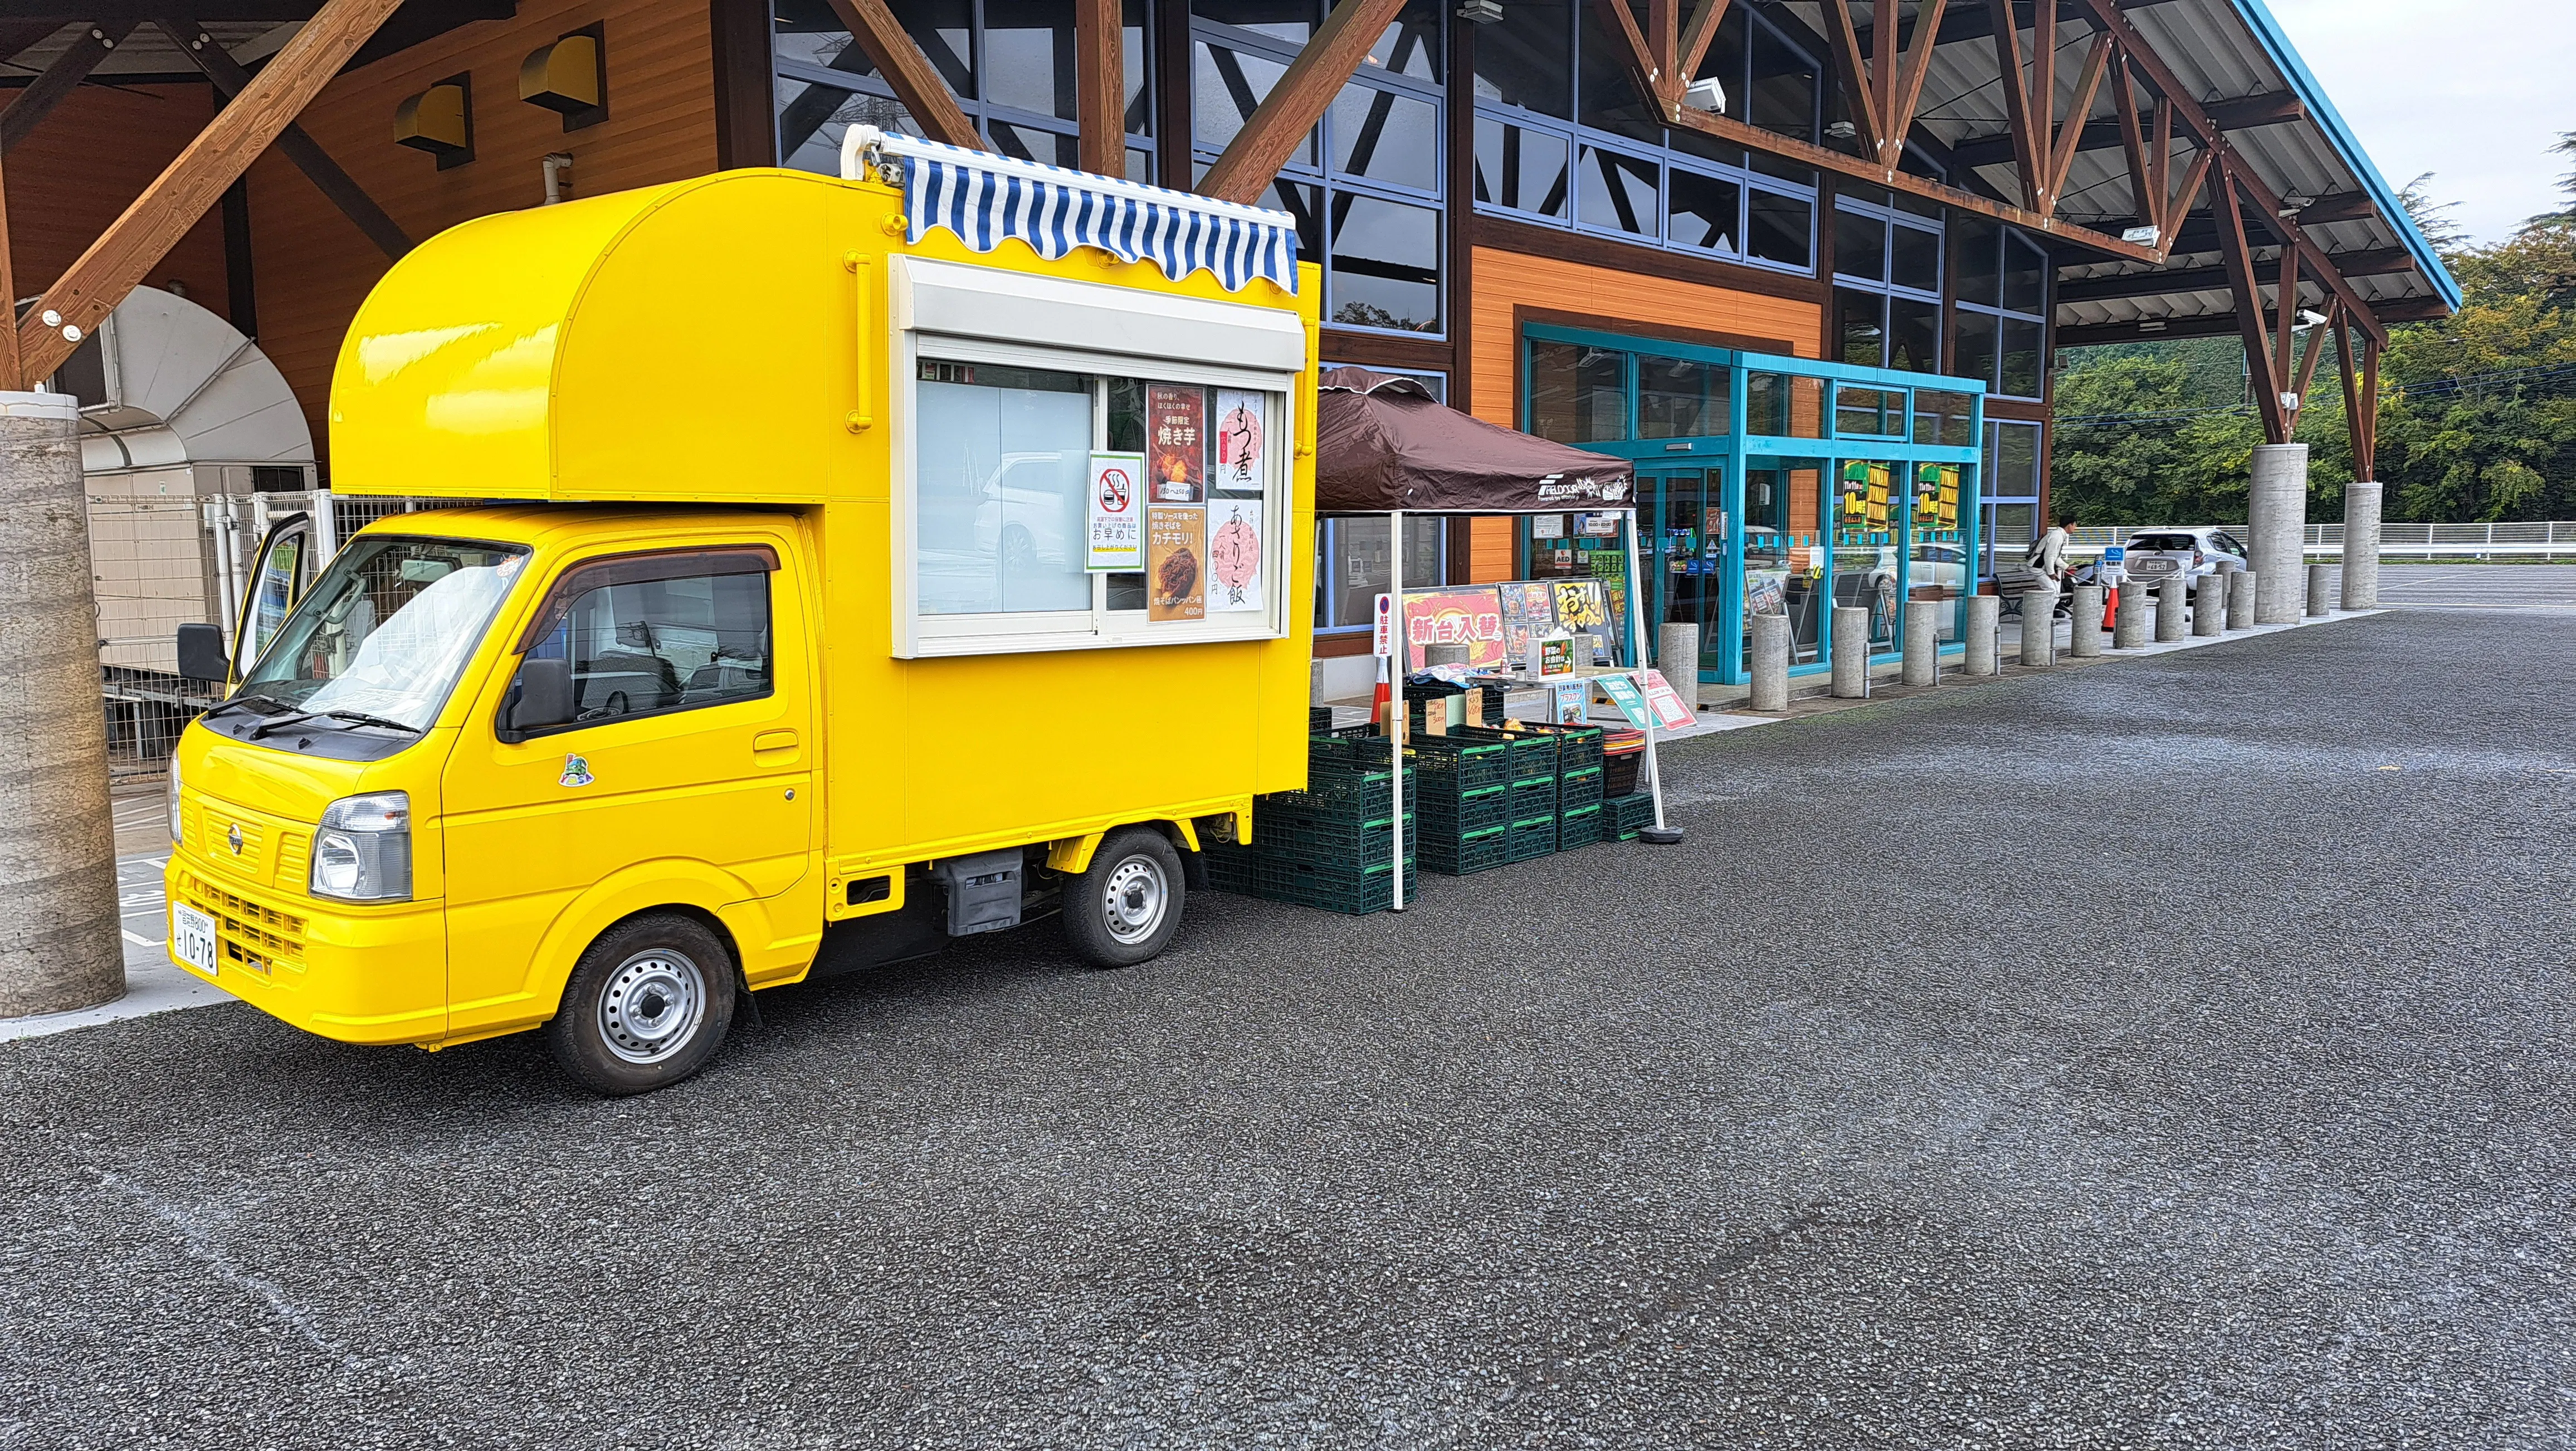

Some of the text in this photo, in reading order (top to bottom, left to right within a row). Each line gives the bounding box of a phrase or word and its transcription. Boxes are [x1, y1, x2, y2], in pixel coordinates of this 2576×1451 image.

[1165, 416, 1189, 425] 季節限定
[1158, 426, 1196, 446] 焼き芋
[1233, 400, 1252, 483] もつ煮
[1093, 528, 1136, 541] お早めに
[1152, 521, 1181, 530] 焼きそばを
[1227, 504, 1246, 606] あさりご飯
[1184, 607, 1203, 616] 400円
[1379, 616, 1389, 655] 駐車禁止
[1412, 615, 1497, 642] 新台入替
[184, 928, 213, 968] 10-78
